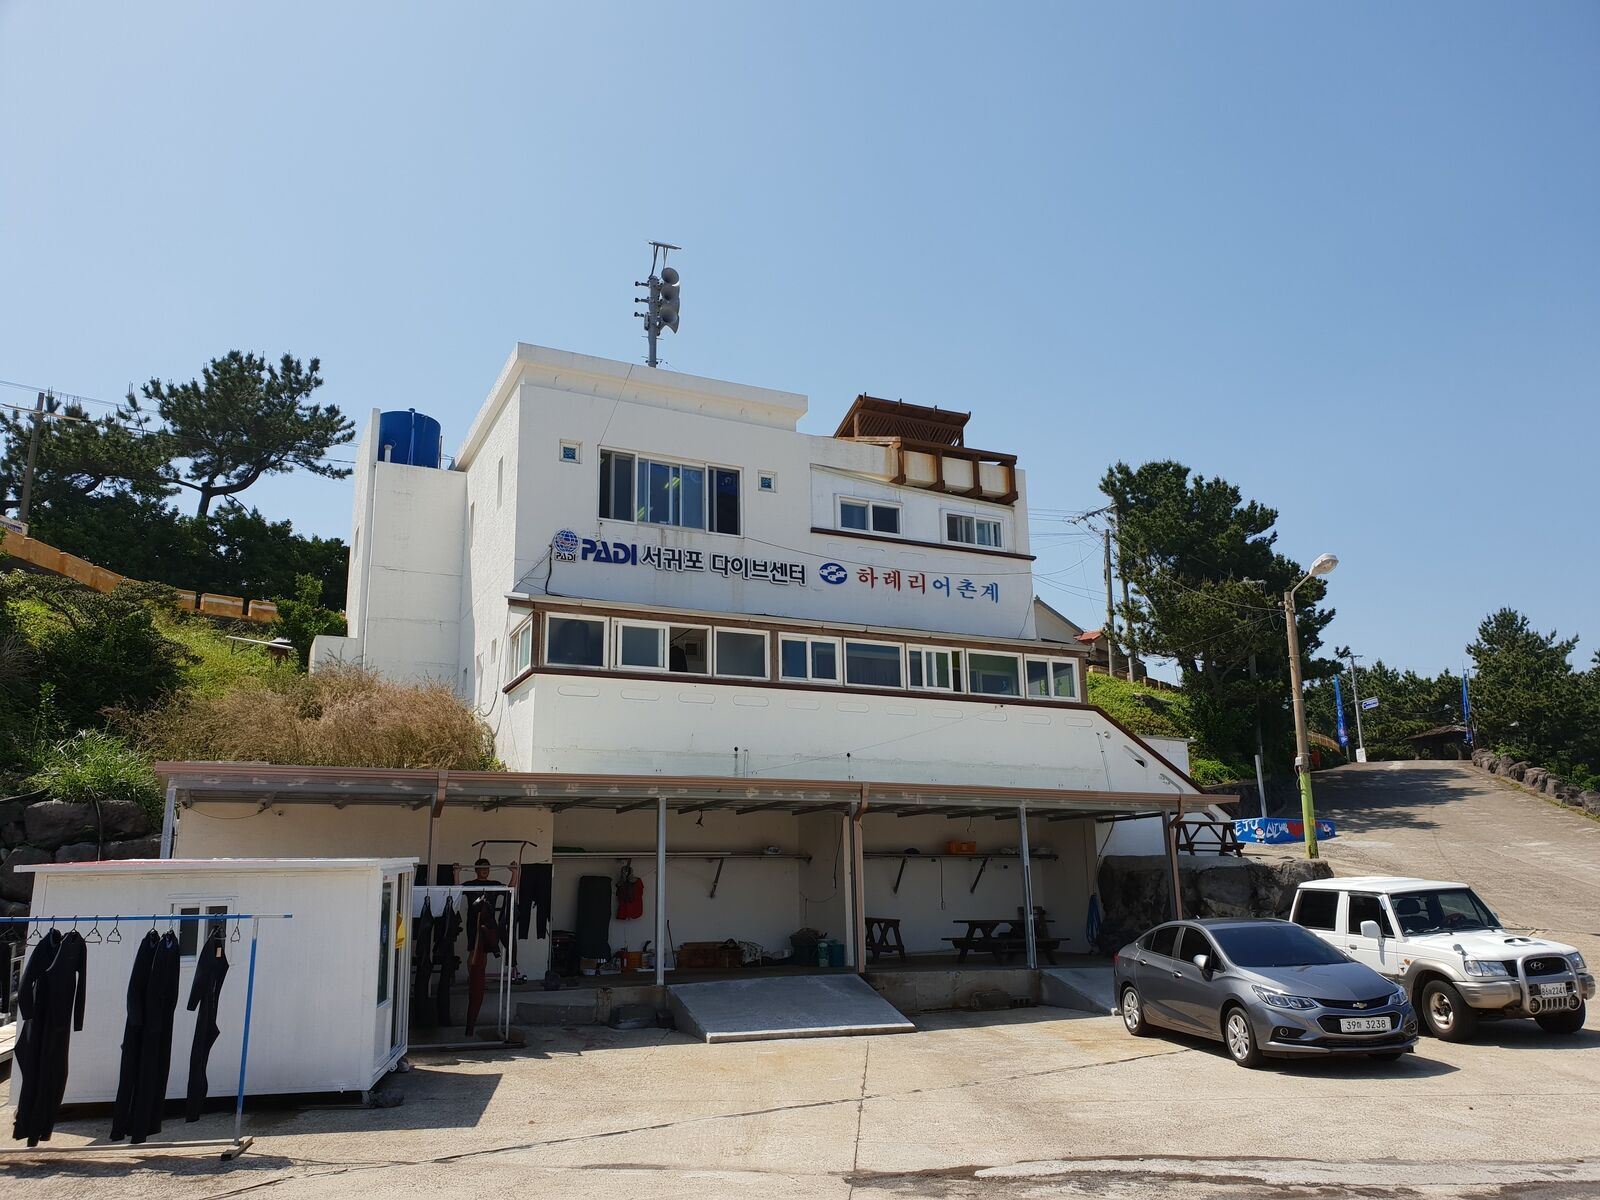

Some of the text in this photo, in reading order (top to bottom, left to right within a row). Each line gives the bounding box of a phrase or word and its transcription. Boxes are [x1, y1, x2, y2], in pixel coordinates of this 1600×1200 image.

[556, 552, 576, 562] PADI
[581, 538, 806, 585] PADI 서귀포 다이브센터
[1233, 818, 1259, 836] EJU
[1366, 1019, 1387, 1029] 3238
